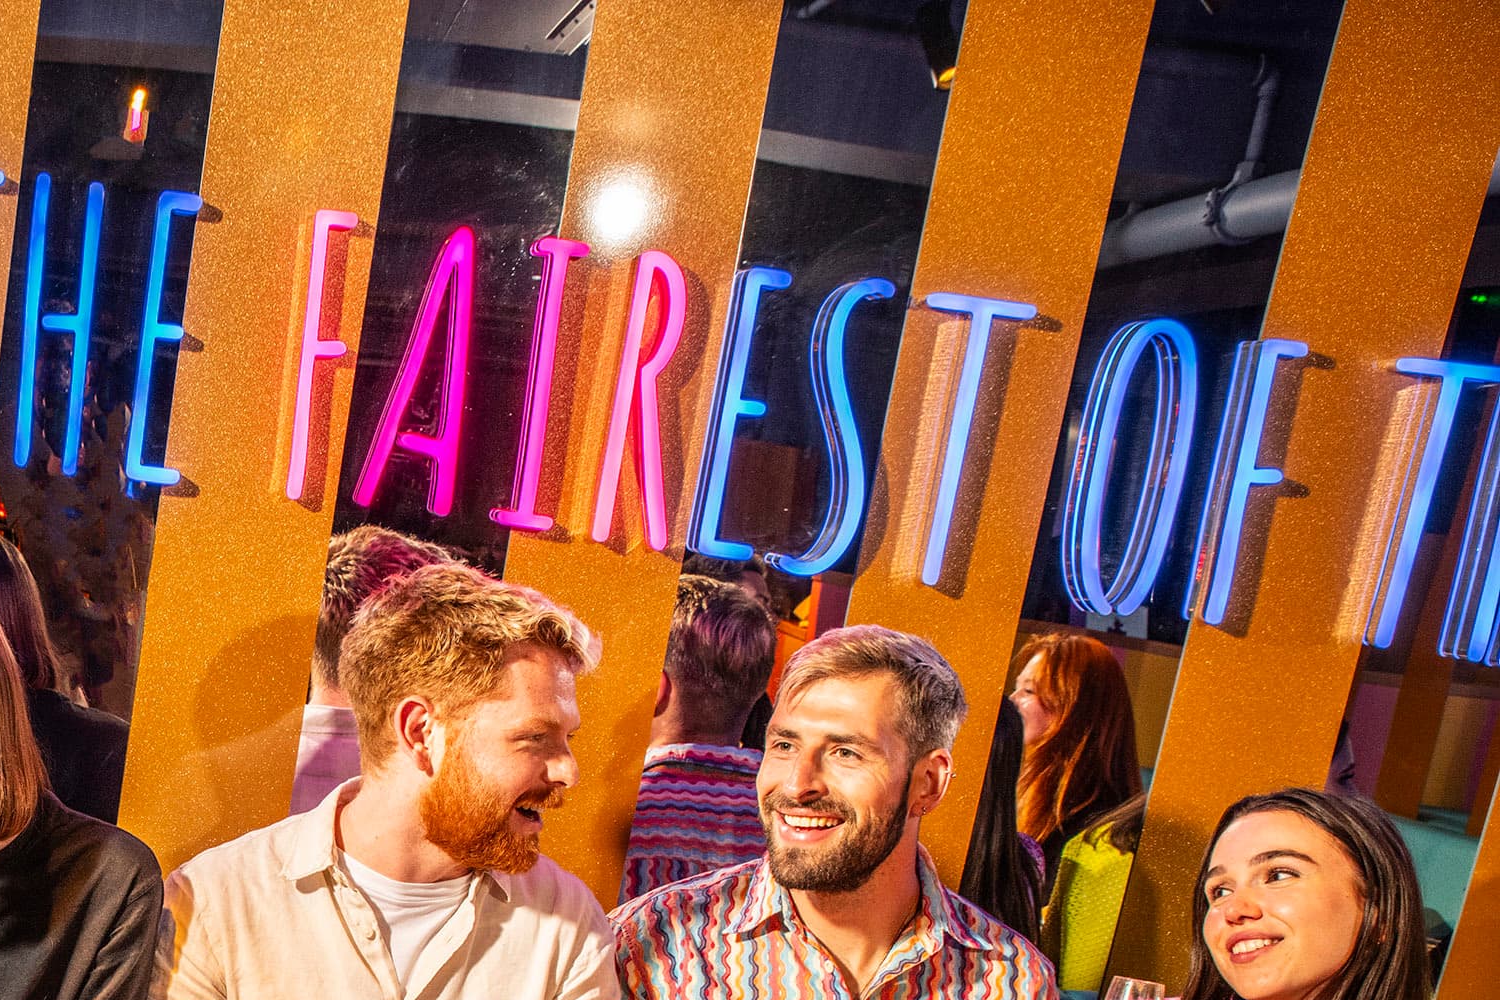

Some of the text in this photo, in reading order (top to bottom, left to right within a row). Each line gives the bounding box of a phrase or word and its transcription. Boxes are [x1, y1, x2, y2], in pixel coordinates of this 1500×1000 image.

[286, 208, 1038, 585] FAIREST
[1061, 318, 1309, 625] OF
[1364, 356, 1500, 669] T
